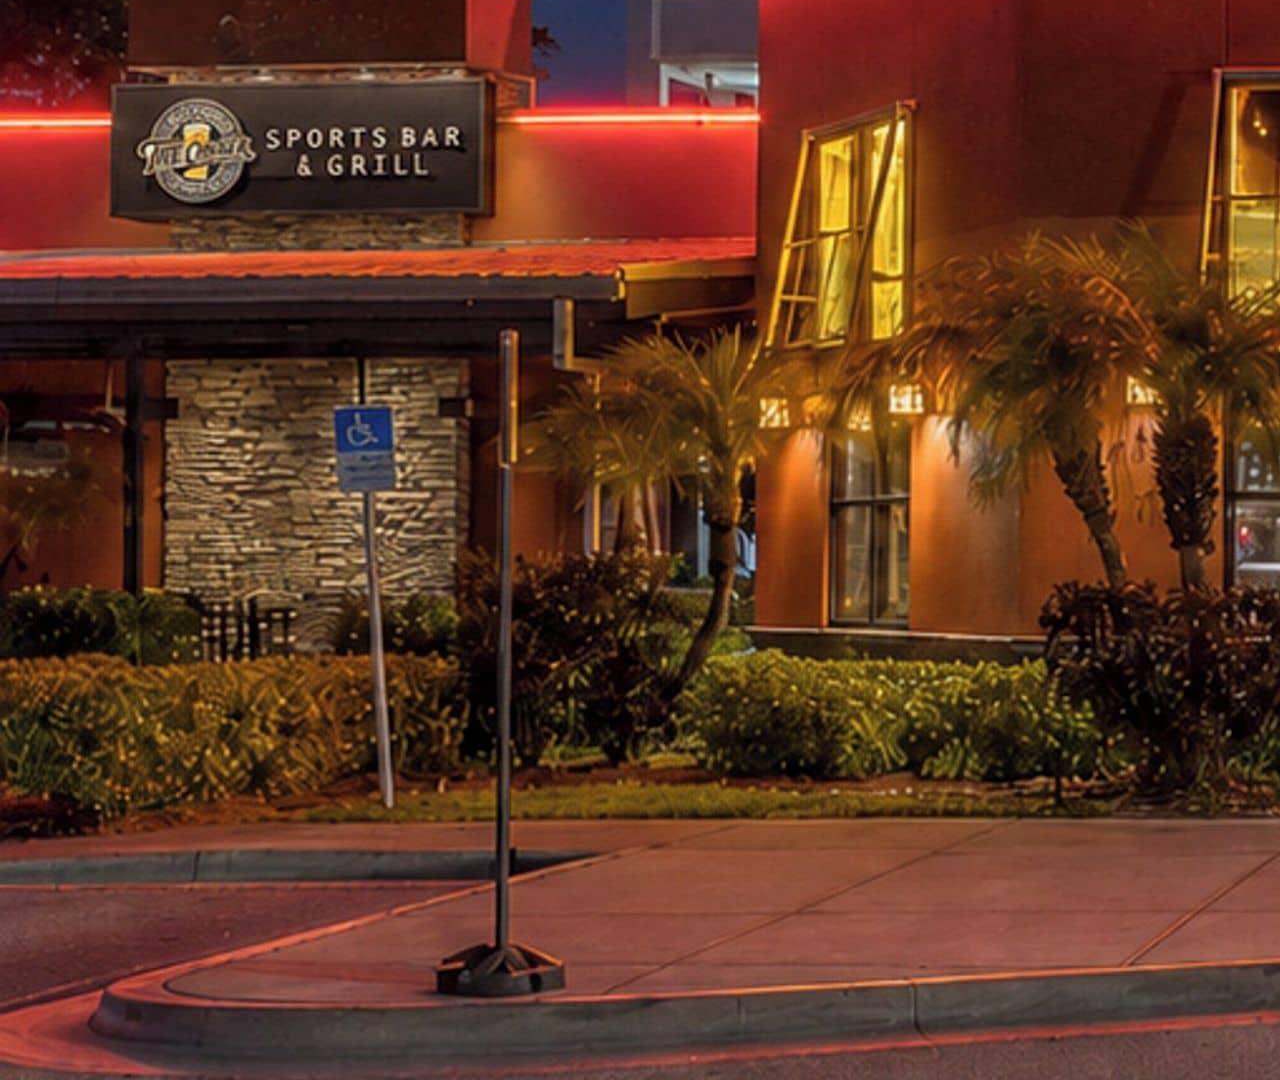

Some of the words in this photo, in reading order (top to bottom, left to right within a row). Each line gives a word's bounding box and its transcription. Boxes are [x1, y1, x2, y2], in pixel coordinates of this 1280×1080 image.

[265, 127, 387, 150] SPORTS
[401, 125, 461, 148] BAR
[296, 155, 312, 176] &
[326, 153, 429, 177] GRILL
